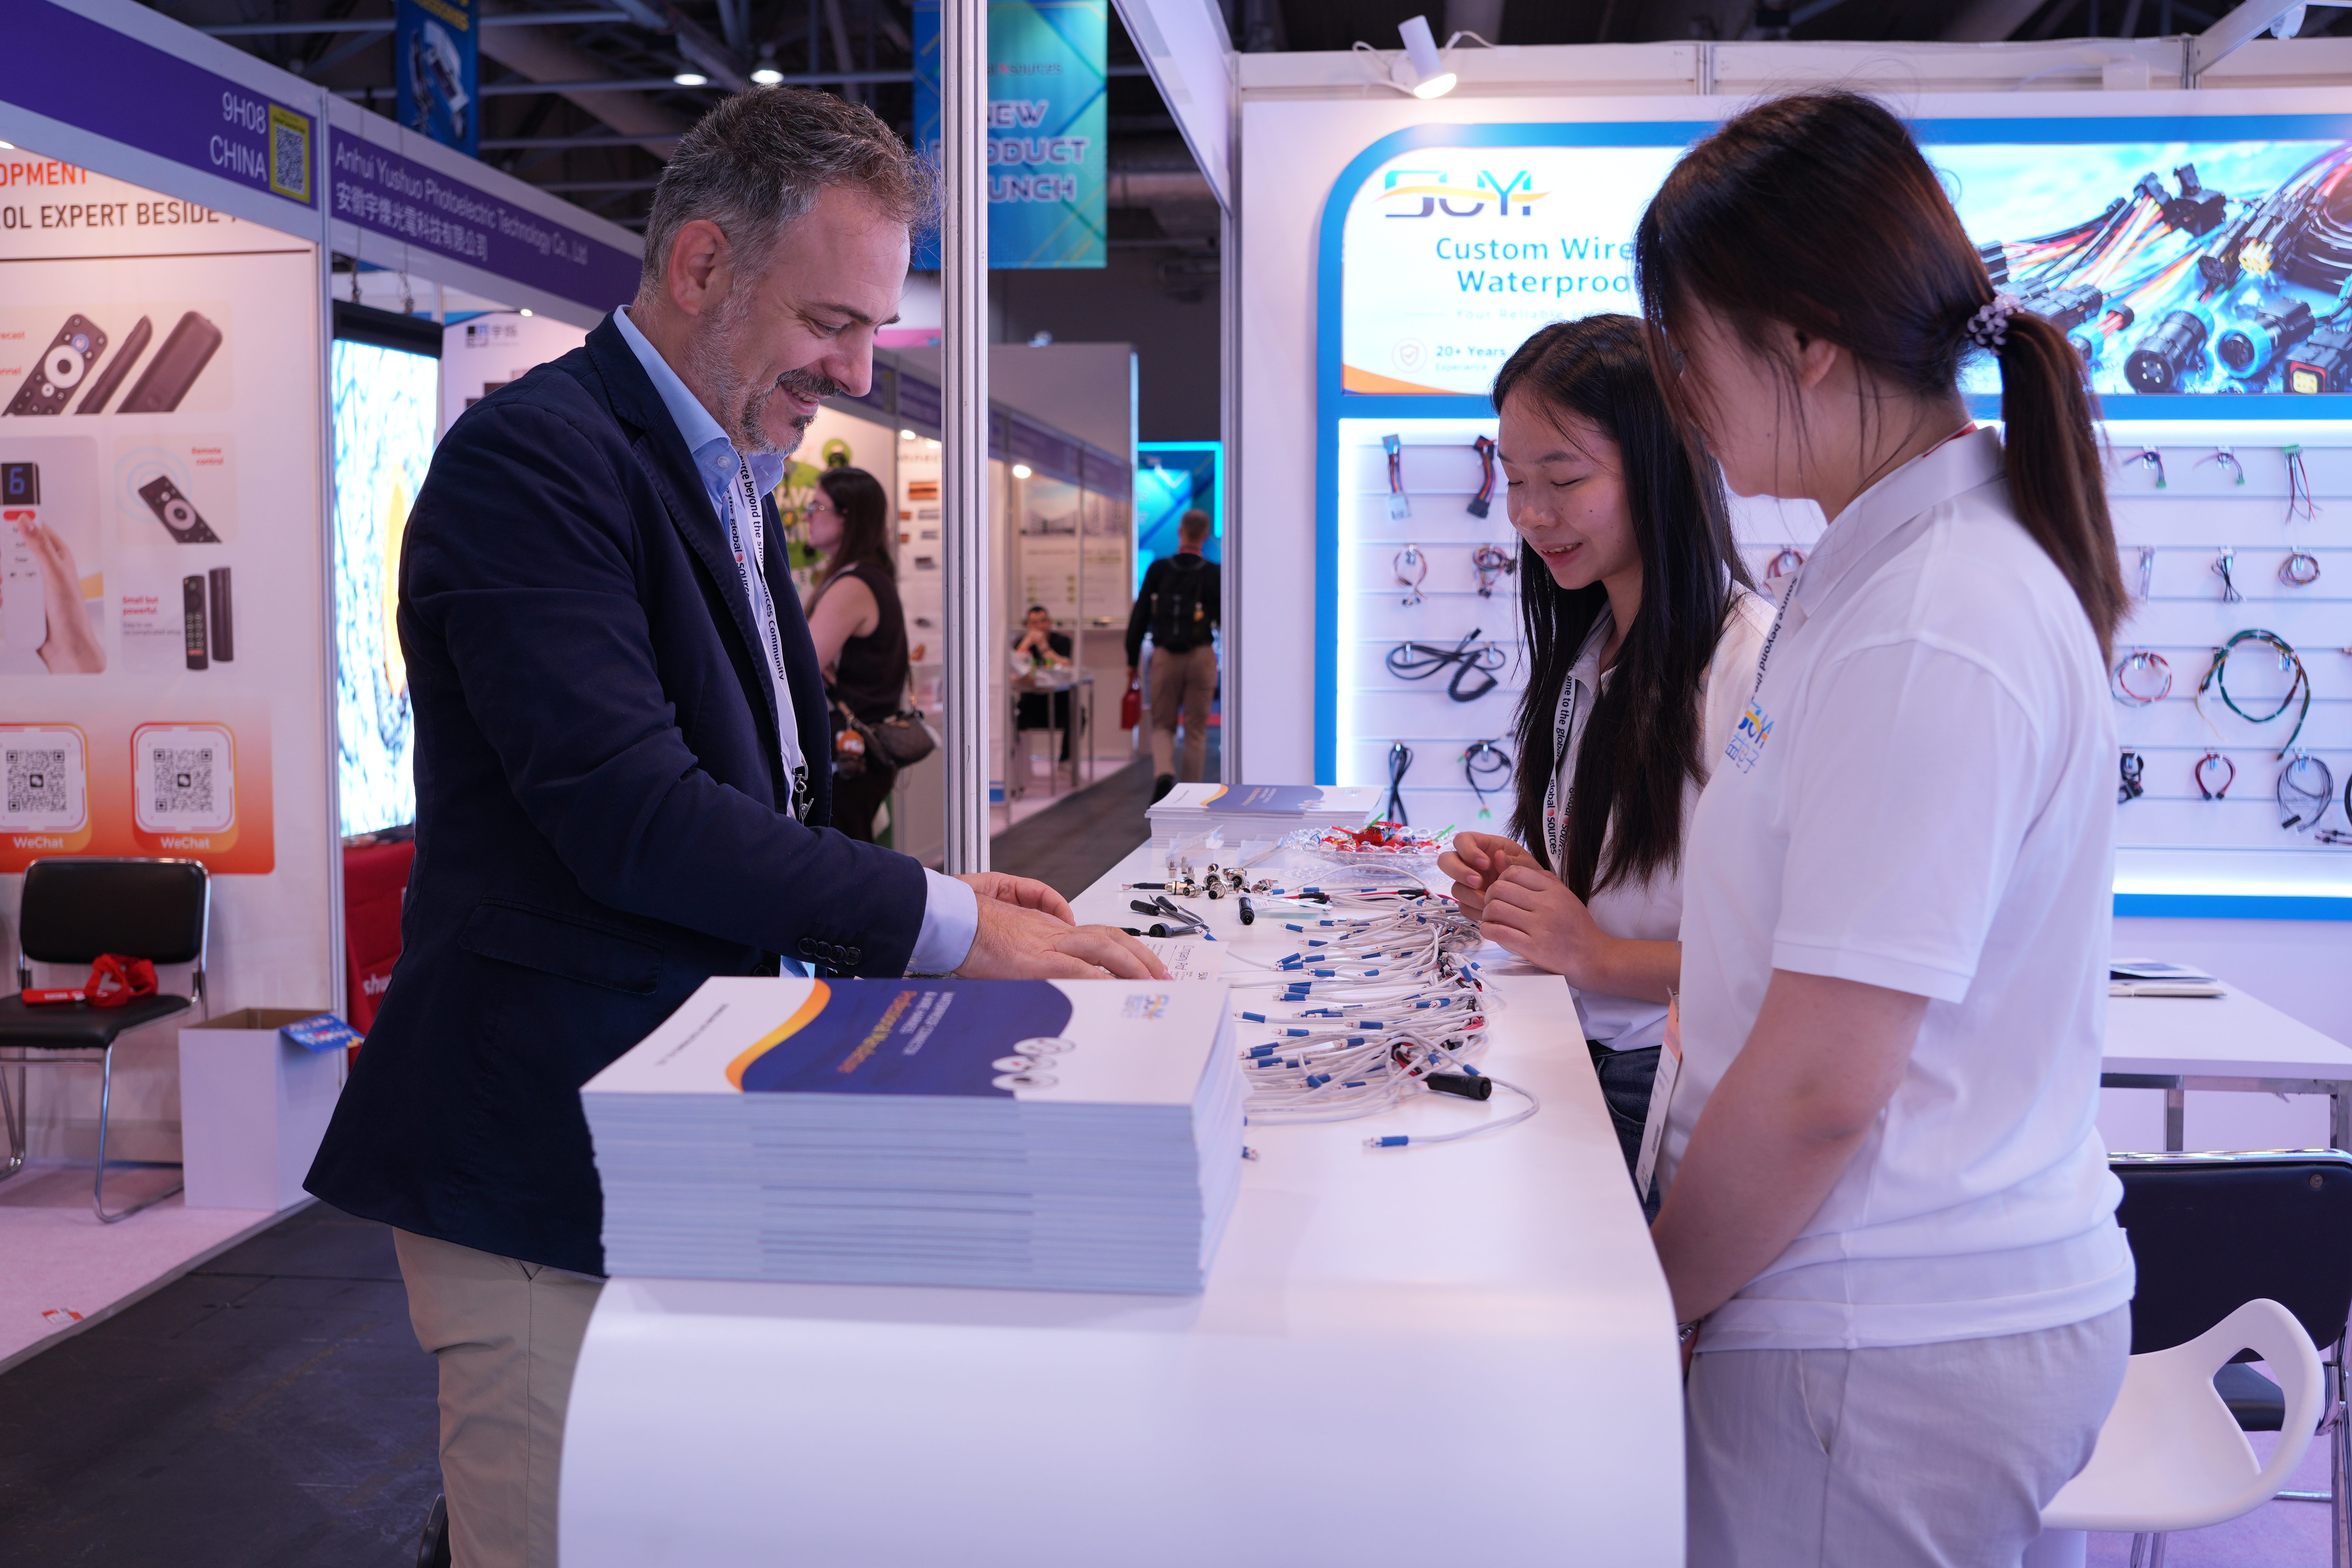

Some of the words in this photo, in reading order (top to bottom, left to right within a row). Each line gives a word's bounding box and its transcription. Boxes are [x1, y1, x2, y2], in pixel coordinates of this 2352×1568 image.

[223, 92, 267, 134] 9H08
[210, 135, 267, 182] CHINA
[335, 141, 375, 180] Anhui
[376, 157, 423, 199] Yushuo
[41, 204, 128, 228] EXPERT
[137, 201, 220, 225] BESIDE
[1437, 238, 1548, 259] Custom
[1458, 270, 1630, 297] Waterproo
[1456, 310, 1491, 319] Your
[1436, 346, 1461, 357] 20+
[1467, 346, 1506, 357] Years
[738, 451, 749, 480] ource
[744, 481, 760, 518] beyond
[730, 518, 743, 553] global
[1778, 576, 1797, 620] Source
[761, 580, 773, 617] ources
[768, 620, 784, 680] Community
[1759, 624, 1781, 671] beyond
[1754, 672, 1762, 692] the
[1562, 698, 1571, 707] to
[1559, 709, 1569, 725] the
[1547, 779, 1555, 808] global
[13, 837, 64, 850] WeChat
[161, 837, 210, 850] WeChat
[1547, 817, 1557, 855] sources
[1175, 945, 1194, 962] Company
